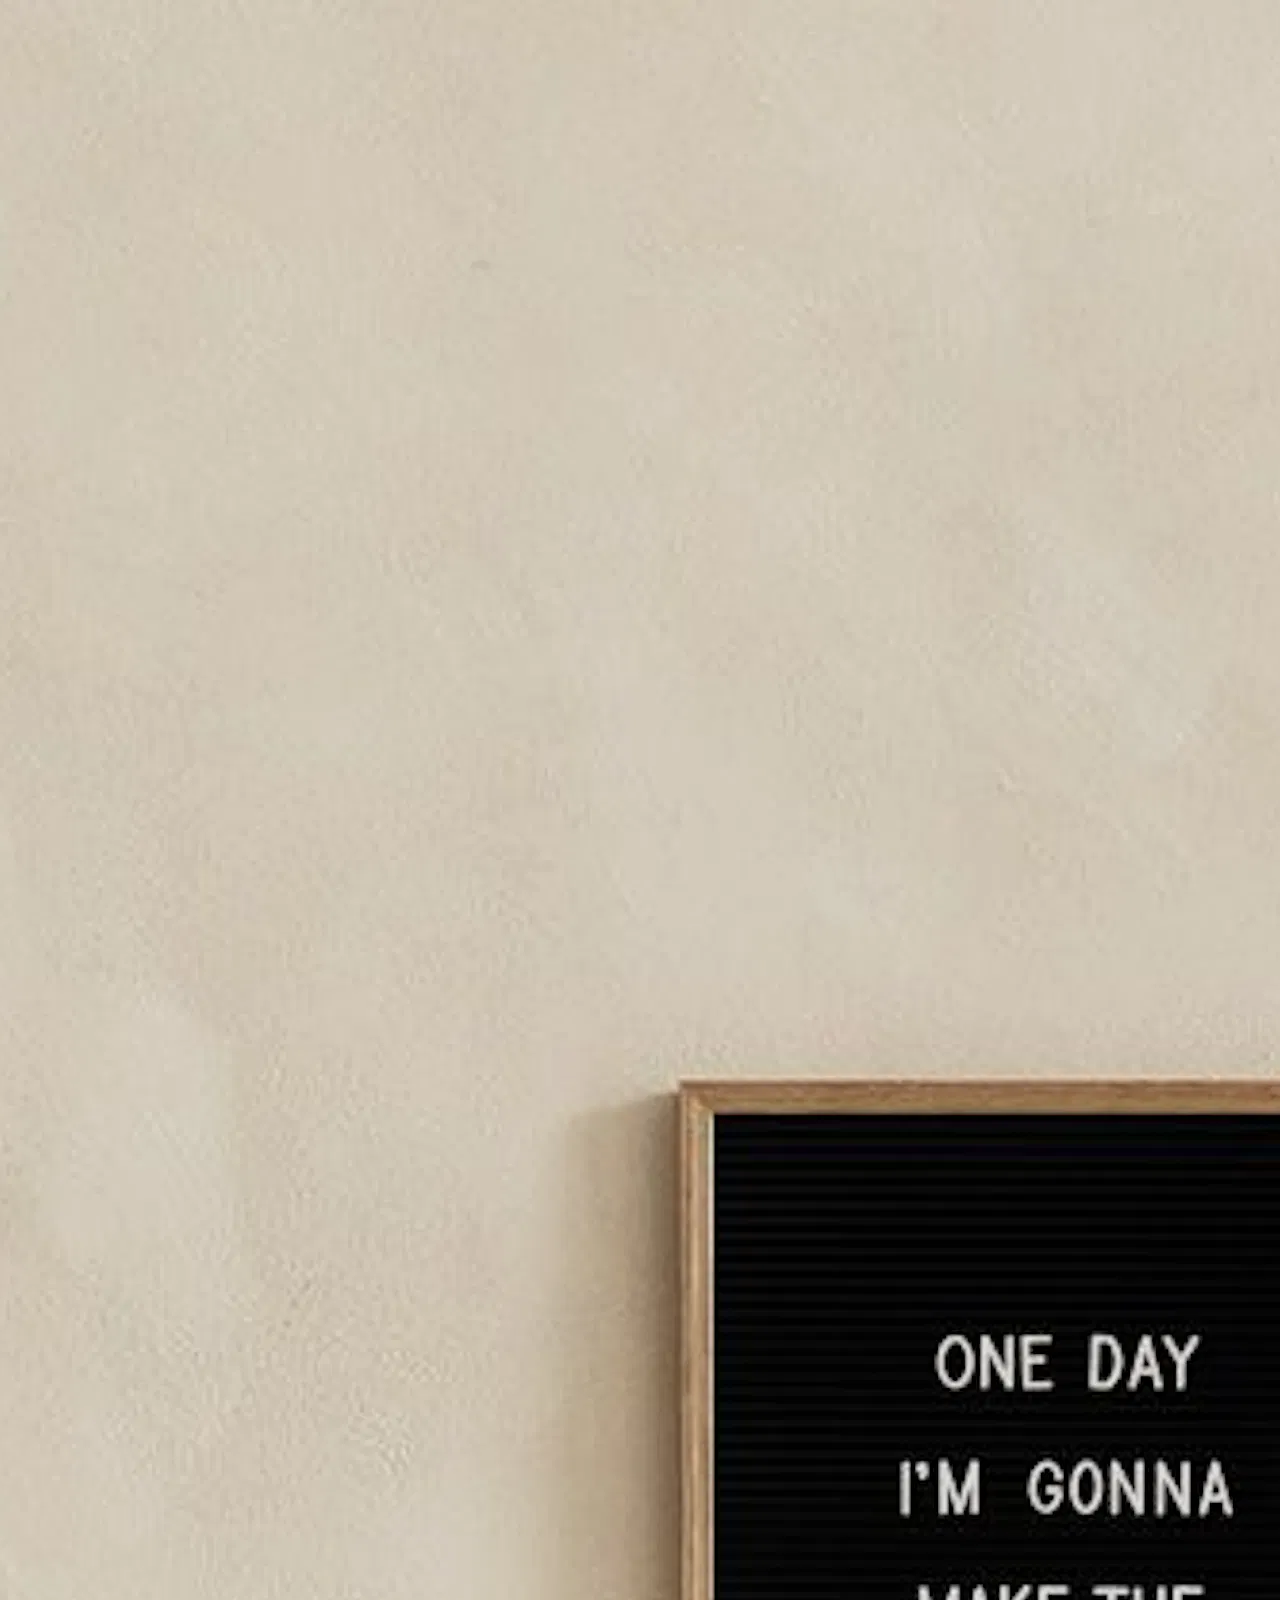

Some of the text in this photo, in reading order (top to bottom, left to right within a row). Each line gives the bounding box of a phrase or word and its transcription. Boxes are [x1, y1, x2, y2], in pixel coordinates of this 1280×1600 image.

[935, 1333, 1200, 1391] ONE DAY
[899, 1458, 1234, 1517] I'M GONNA
